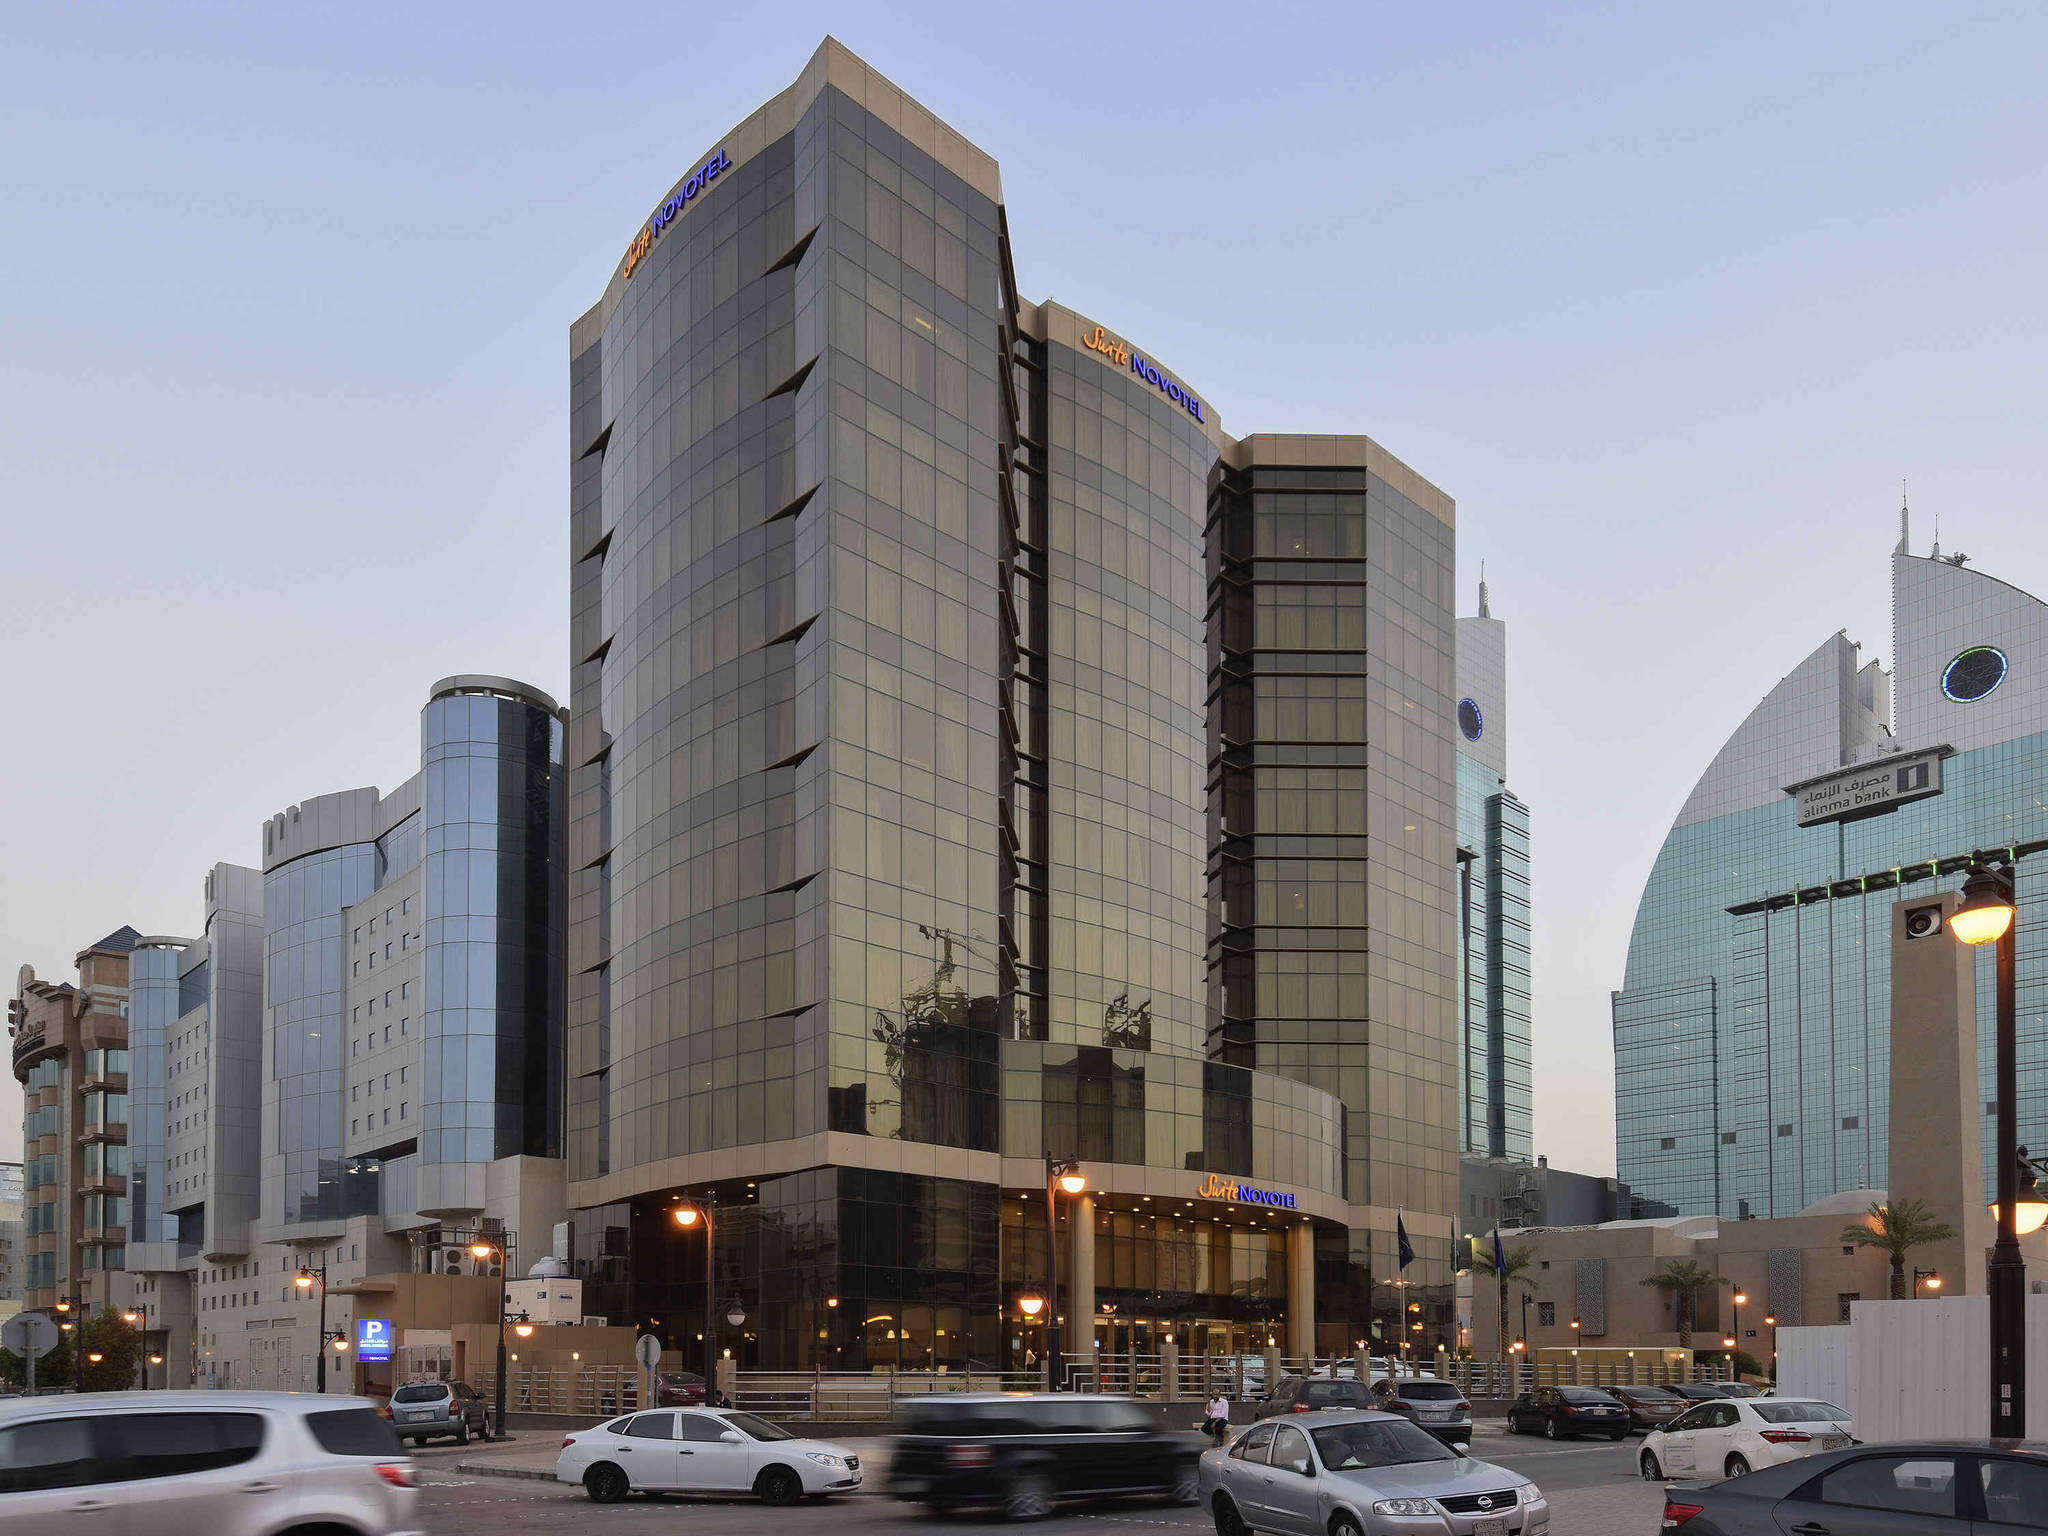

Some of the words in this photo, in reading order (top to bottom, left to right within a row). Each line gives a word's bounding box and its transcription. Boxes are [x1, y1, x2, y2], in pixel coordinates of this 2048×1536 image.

[623, 227, 652, 278] Suite
[652, 149, 731, 237] NOVOTEL
[1082, 326, 1128, 365] Suite
[1132, 352, 1205, 423] NOVOTEL
[1844, 774, 1890, 792] مصرف
[1804, 798, 1850, 818] alinma
[1855, 786, 1890, 804] bank
[1198, 1174, 1239, 1200] Suite
[1238, 1184, 1299, 1208] NOVOTEL
[366, 1321, 382, 1339] P
